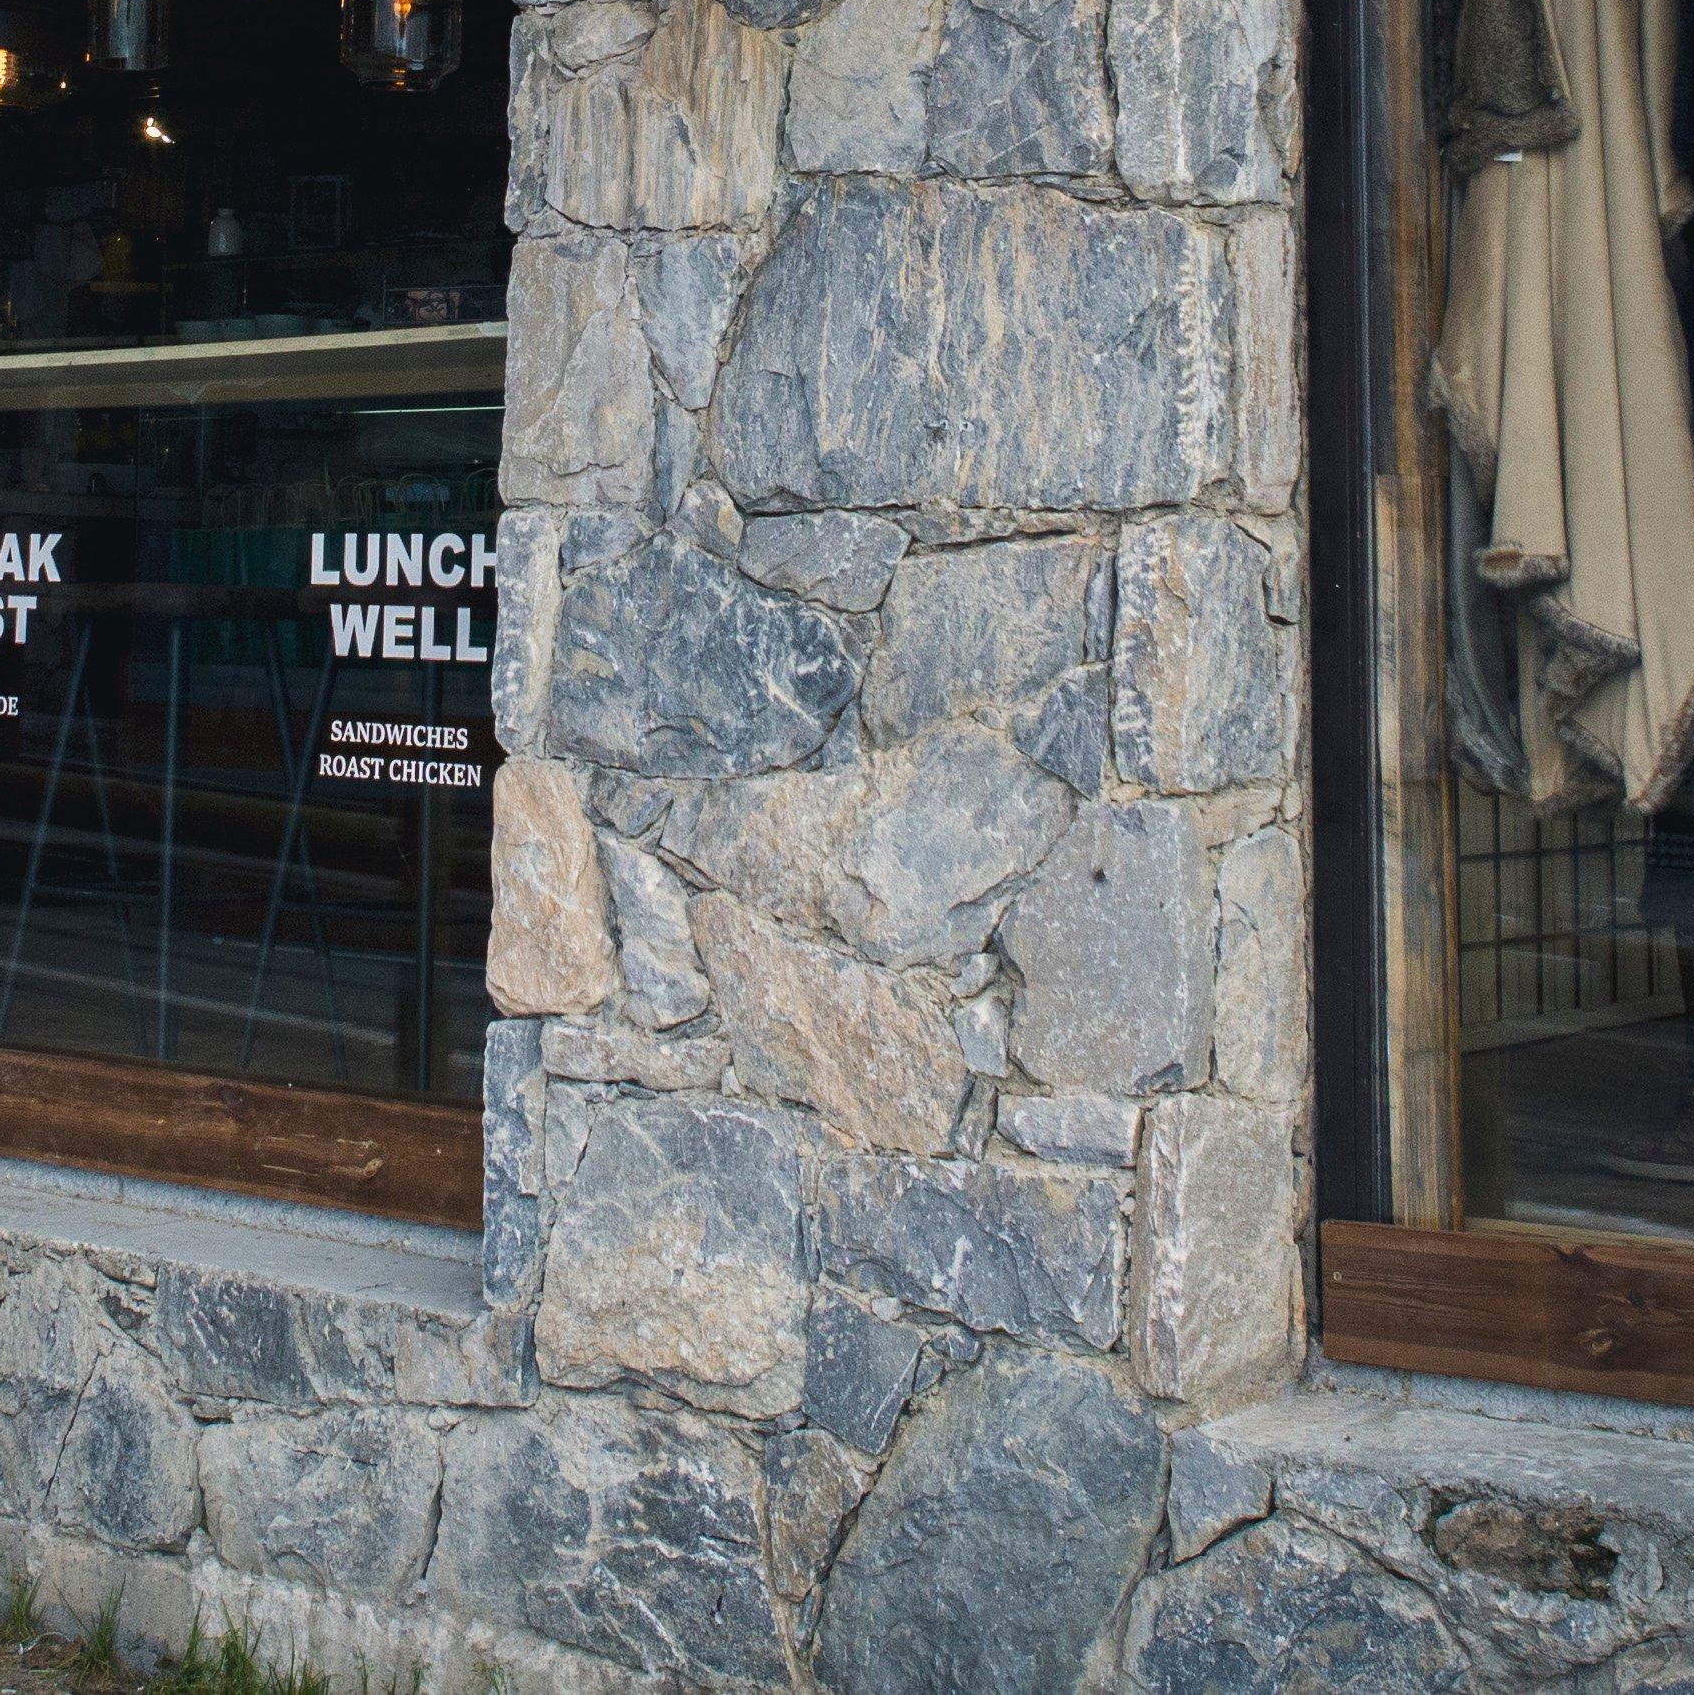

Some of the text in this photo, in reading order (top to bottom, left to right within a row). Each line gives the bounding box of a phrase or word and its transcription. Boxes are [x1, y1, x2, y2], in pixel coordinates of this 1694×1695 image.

[310, 532, 499, 588] LUNCH
[329, 603, 488, 661] WELL
[330, 720, 469, 751] SANDWICHES
[318, 753, 481, 788] ROAST CHICKEN
